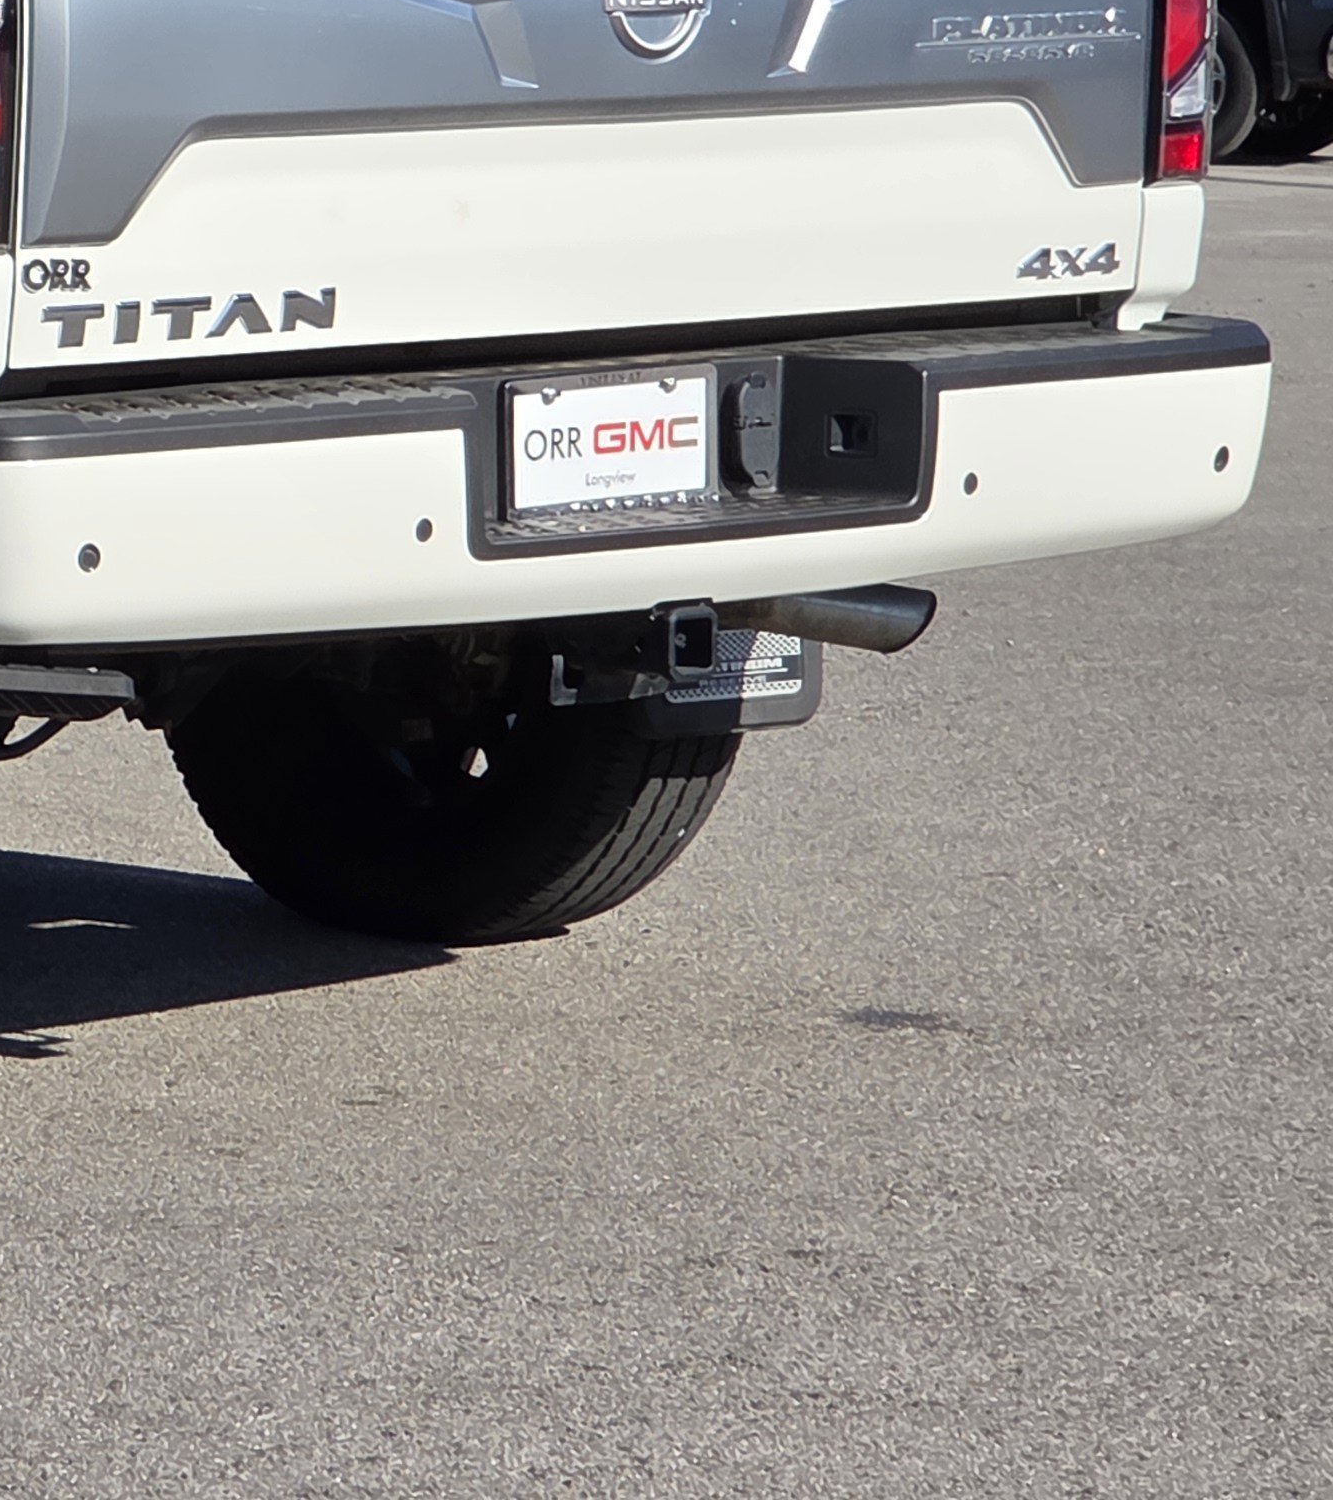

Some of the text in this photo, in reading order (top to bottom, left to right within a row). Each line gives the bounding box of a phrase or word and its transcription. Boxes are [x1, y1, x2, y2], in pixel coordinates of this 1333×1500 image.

[21, 258, 92, 293] ORR
[41, 286, 337, 348] TITAN
[524, 415, 700, 462] ORR GMC
[585, 470, 637, 488] Longview
